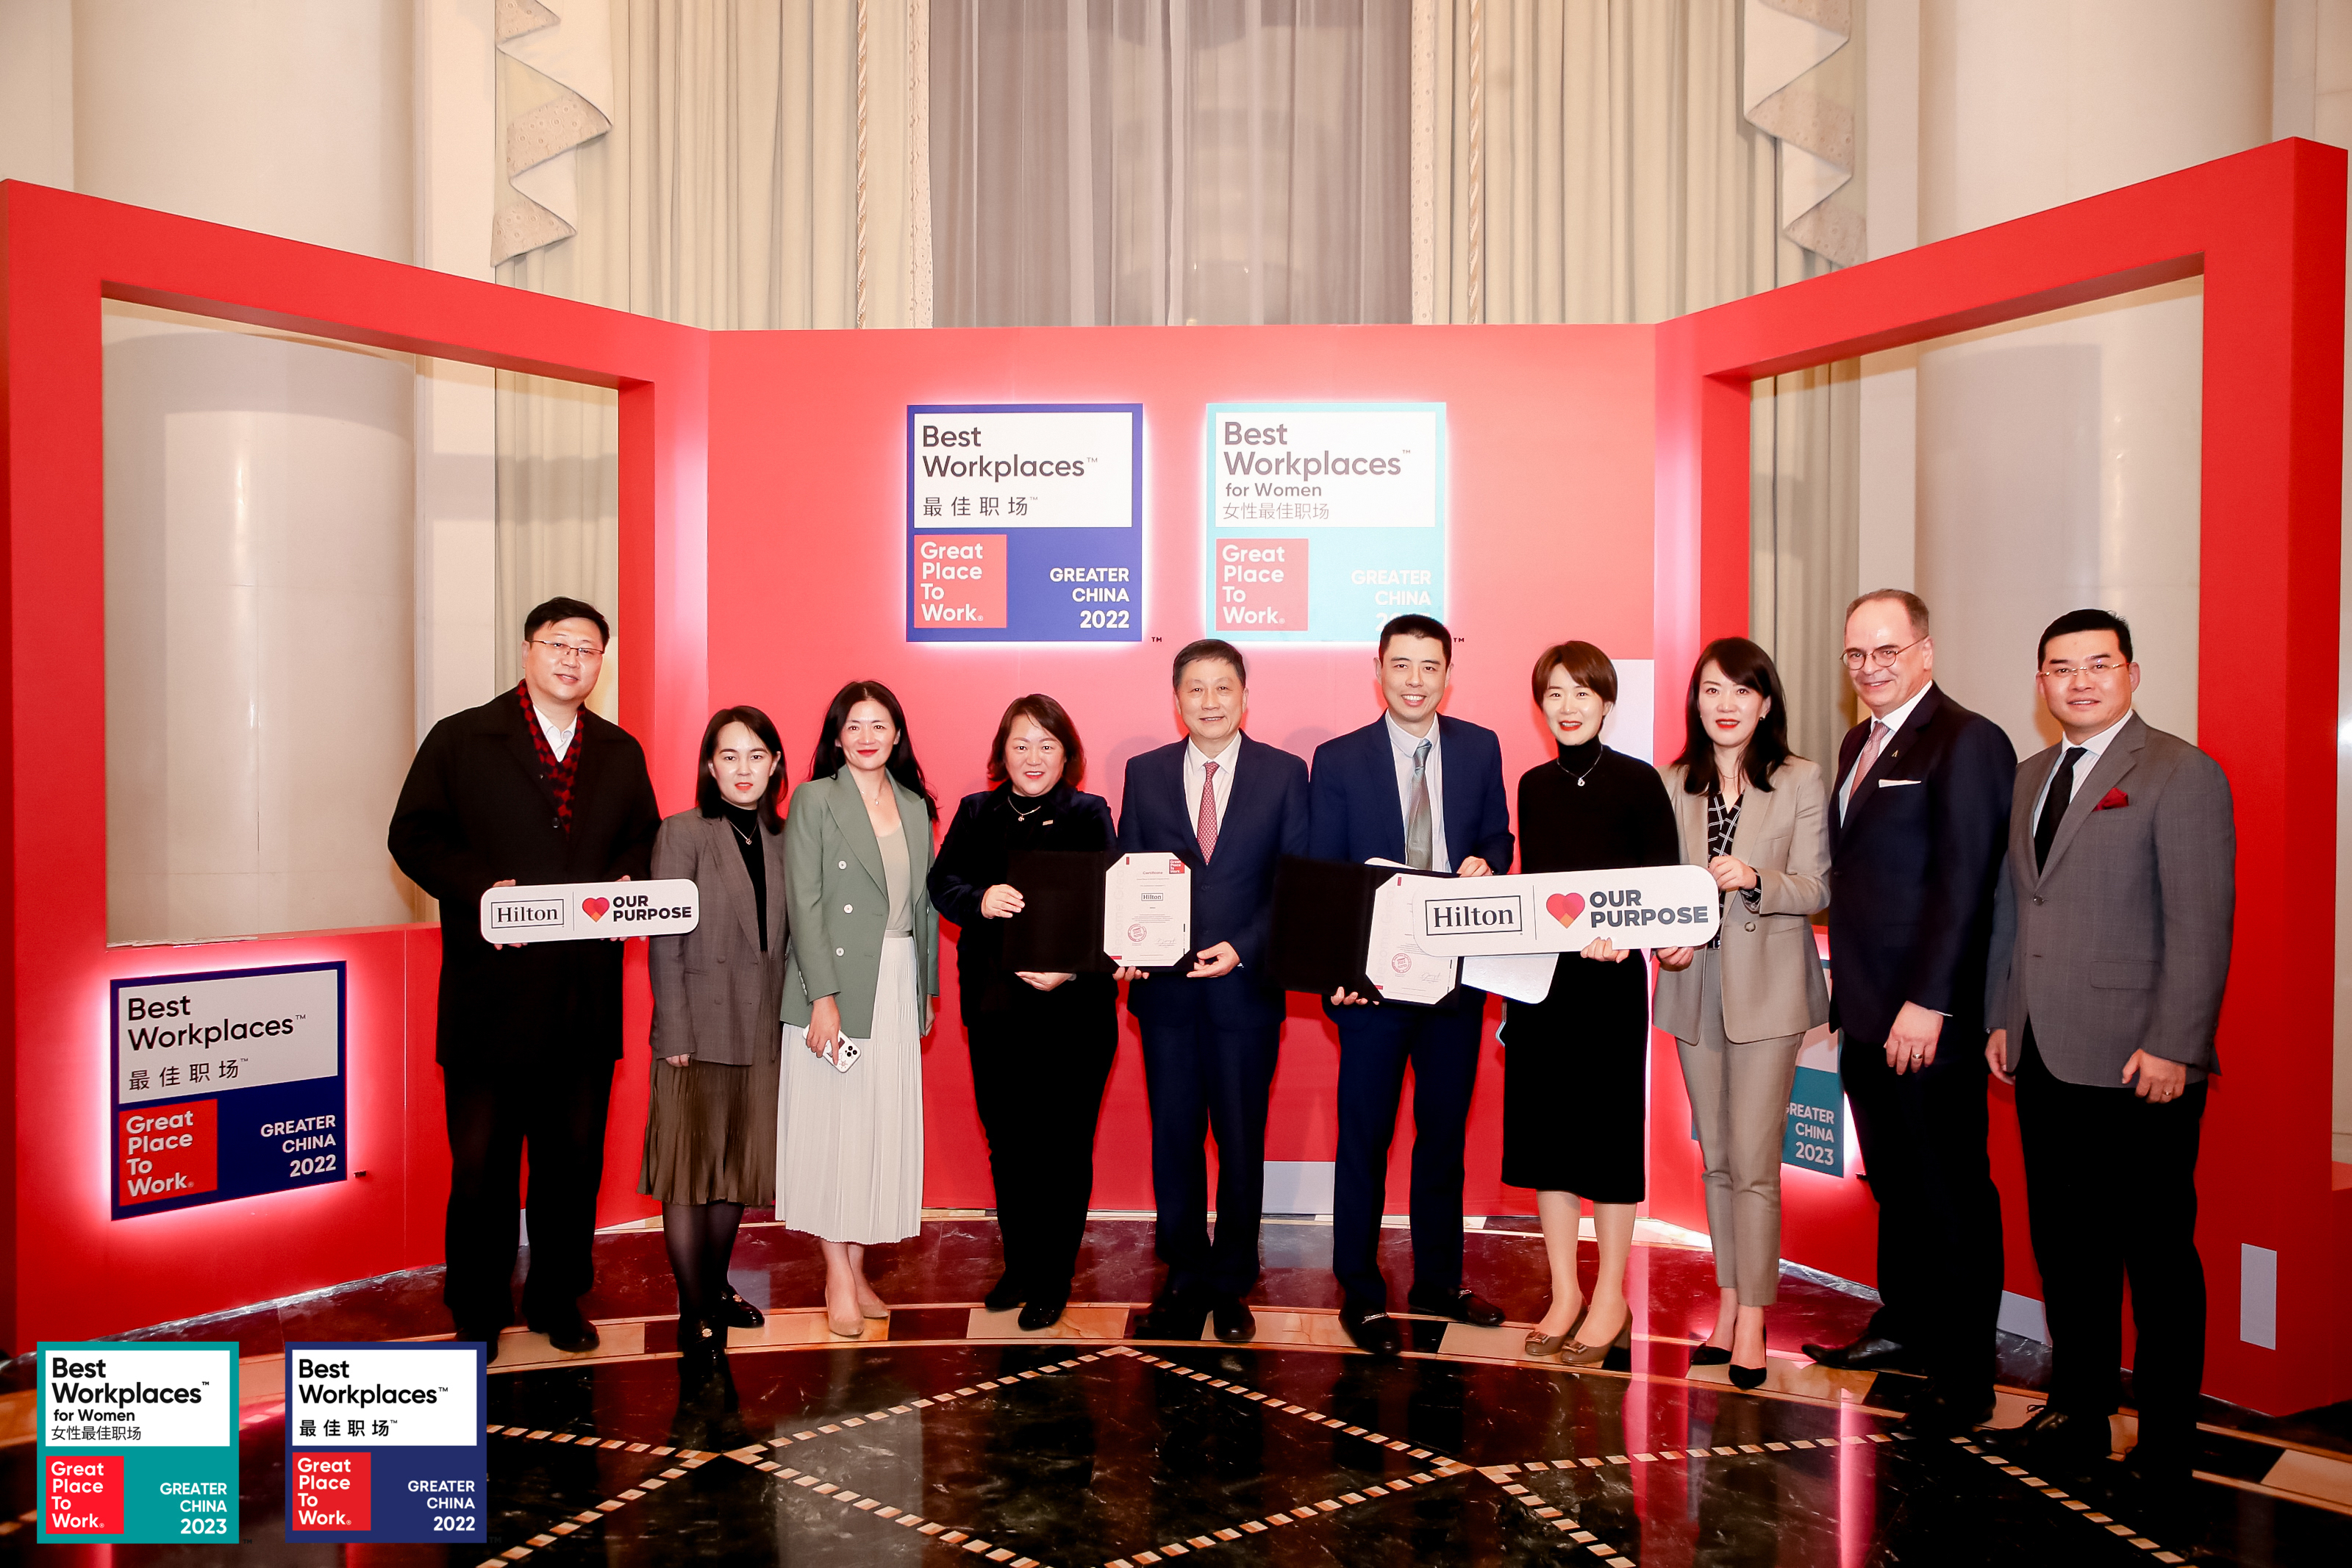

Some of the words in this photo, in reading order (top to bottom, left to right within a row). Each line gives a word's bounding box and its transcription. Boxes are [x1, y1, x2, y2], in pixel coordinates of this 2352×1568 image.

[923, 426, 981, 447] Best
[1225, 422, 1287, 445] Best
[1226, 483, 1249, 496] for
[1255, 483, 1321, 496] Women
[1223, 502, 1329, 519] 女性最佳职场
[921, 542, 983, 559] Great
[1223, 545, 1284, 562] Great
[922, 562, 982, 579] Place
[1049, 568, 1129, 582] GREATER
[1224, 565, 1284, 582] Place
[1351, 570, 1431, 585] GREATER
[921, 583, 944, 600] To
[1072, 588, 1129, 601] CHINA
[1222, 586, 1245, 602] To
[1374, 590, 1431, 606] CHINA
[1079, 610, 1129, 628] 2022
[613, 895, 648, 908] OUR
[1590, 890, 1642, 908] OUR
[498, 907, 557, 922] Hilton
[613, 904, 691, 922] PURPOSE
[1434, 906, 1513, 927] Hilton
[1591, 904, 1708, 928] PURPOSE
[129, 996, 190, 1020] Best
[126, 1111, 193, 1134] Great
[261, 1115, 335, 1139] GREATER
[1795, 1123, 1834, 1143] CHINA
[129, 1134, 193, 1155] Place
[282, 1134, 336, 1153] CHINA
[1796, 1142, 1834, 1165] 2023
[126, 1158, 152, 1175] To
[290, 1154, 336, 1177] 2022
